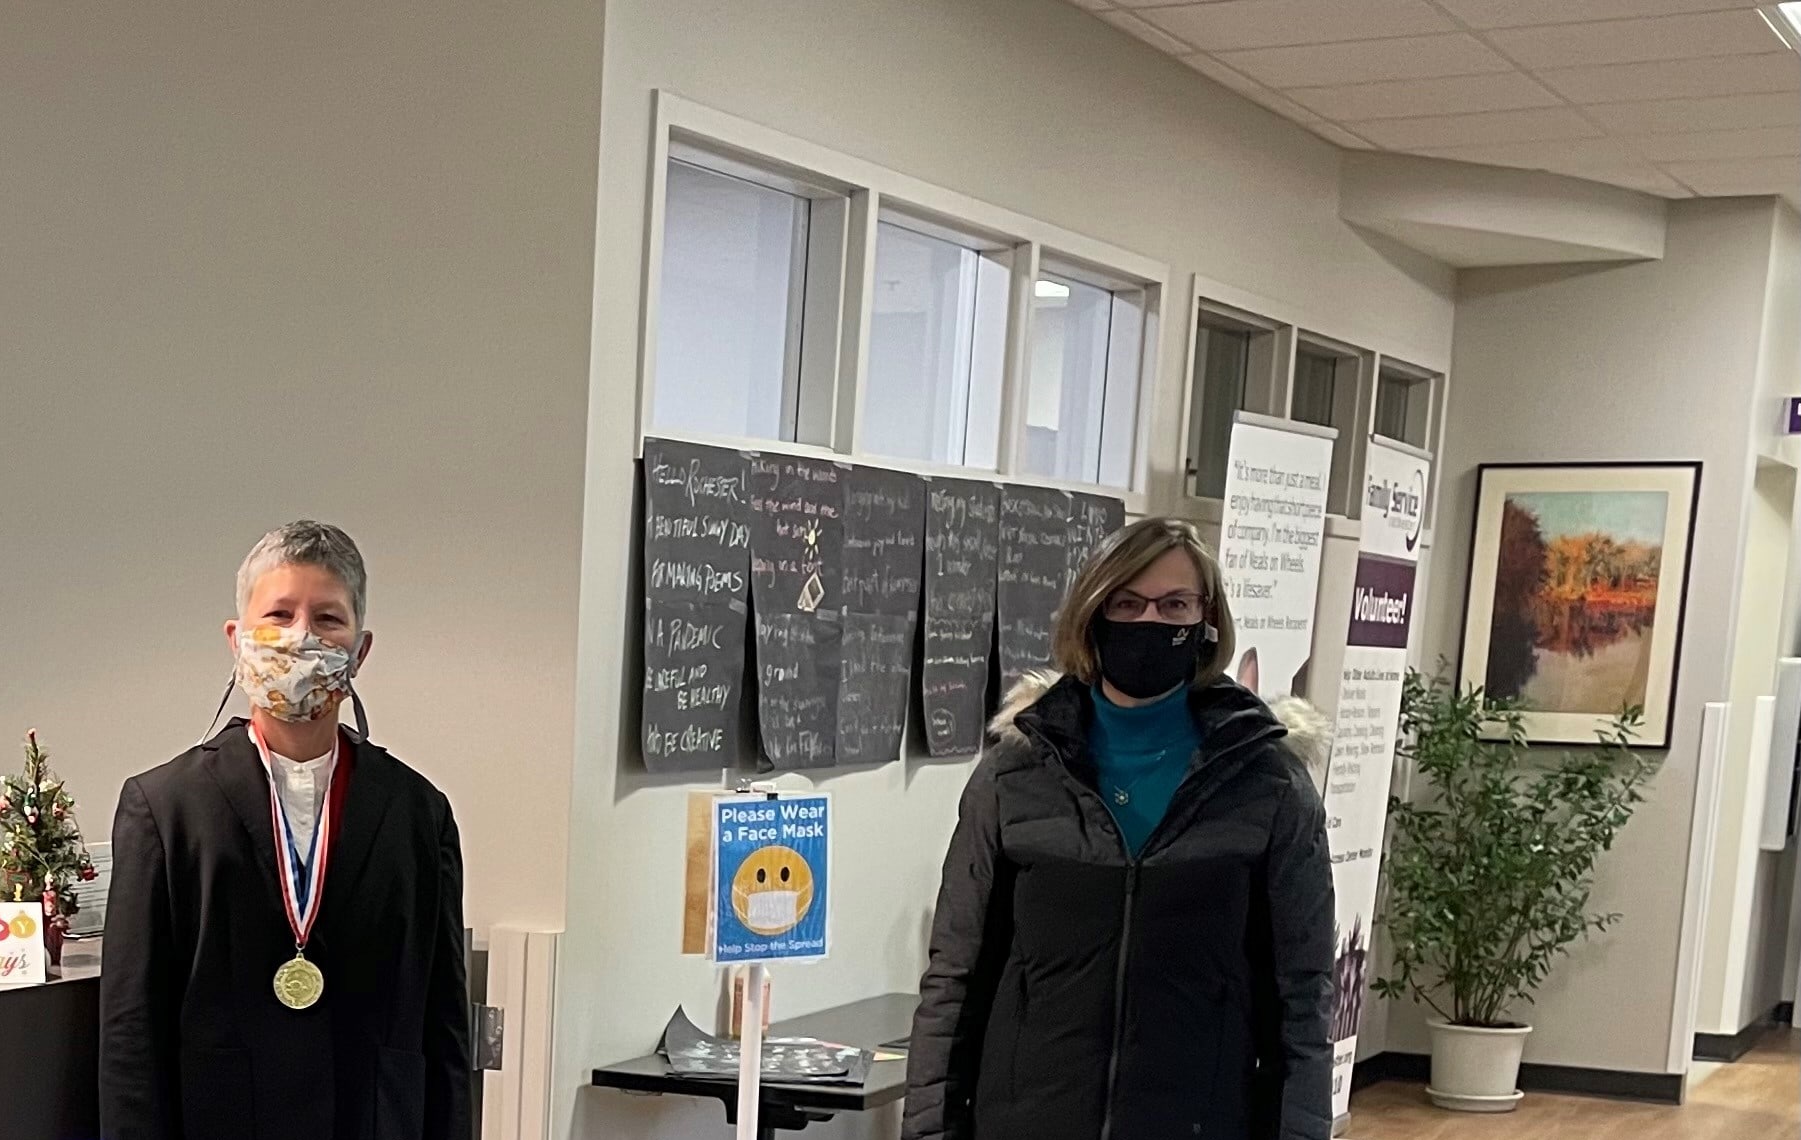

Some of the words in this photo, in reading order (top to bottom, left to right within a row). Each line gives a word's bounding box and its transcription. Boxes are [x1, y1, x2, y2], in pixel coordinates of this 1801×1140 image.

[729, 522, 750, 549] DAY
[1354, 587, 1407, 625] Volunteer!
[722, 808, 775, 823] Please
[780, 805, 825, 819] Wear
[723, 830, 732, 842] a
[738, 826, 777, 841] Face
[783, 822, 824, 838] Mask
[719, 944, 742, 954] Help
[745, 943, 768, 953] Stop
[770, 941, 786, 950] the
[788, 937, 824, 949] Spread
